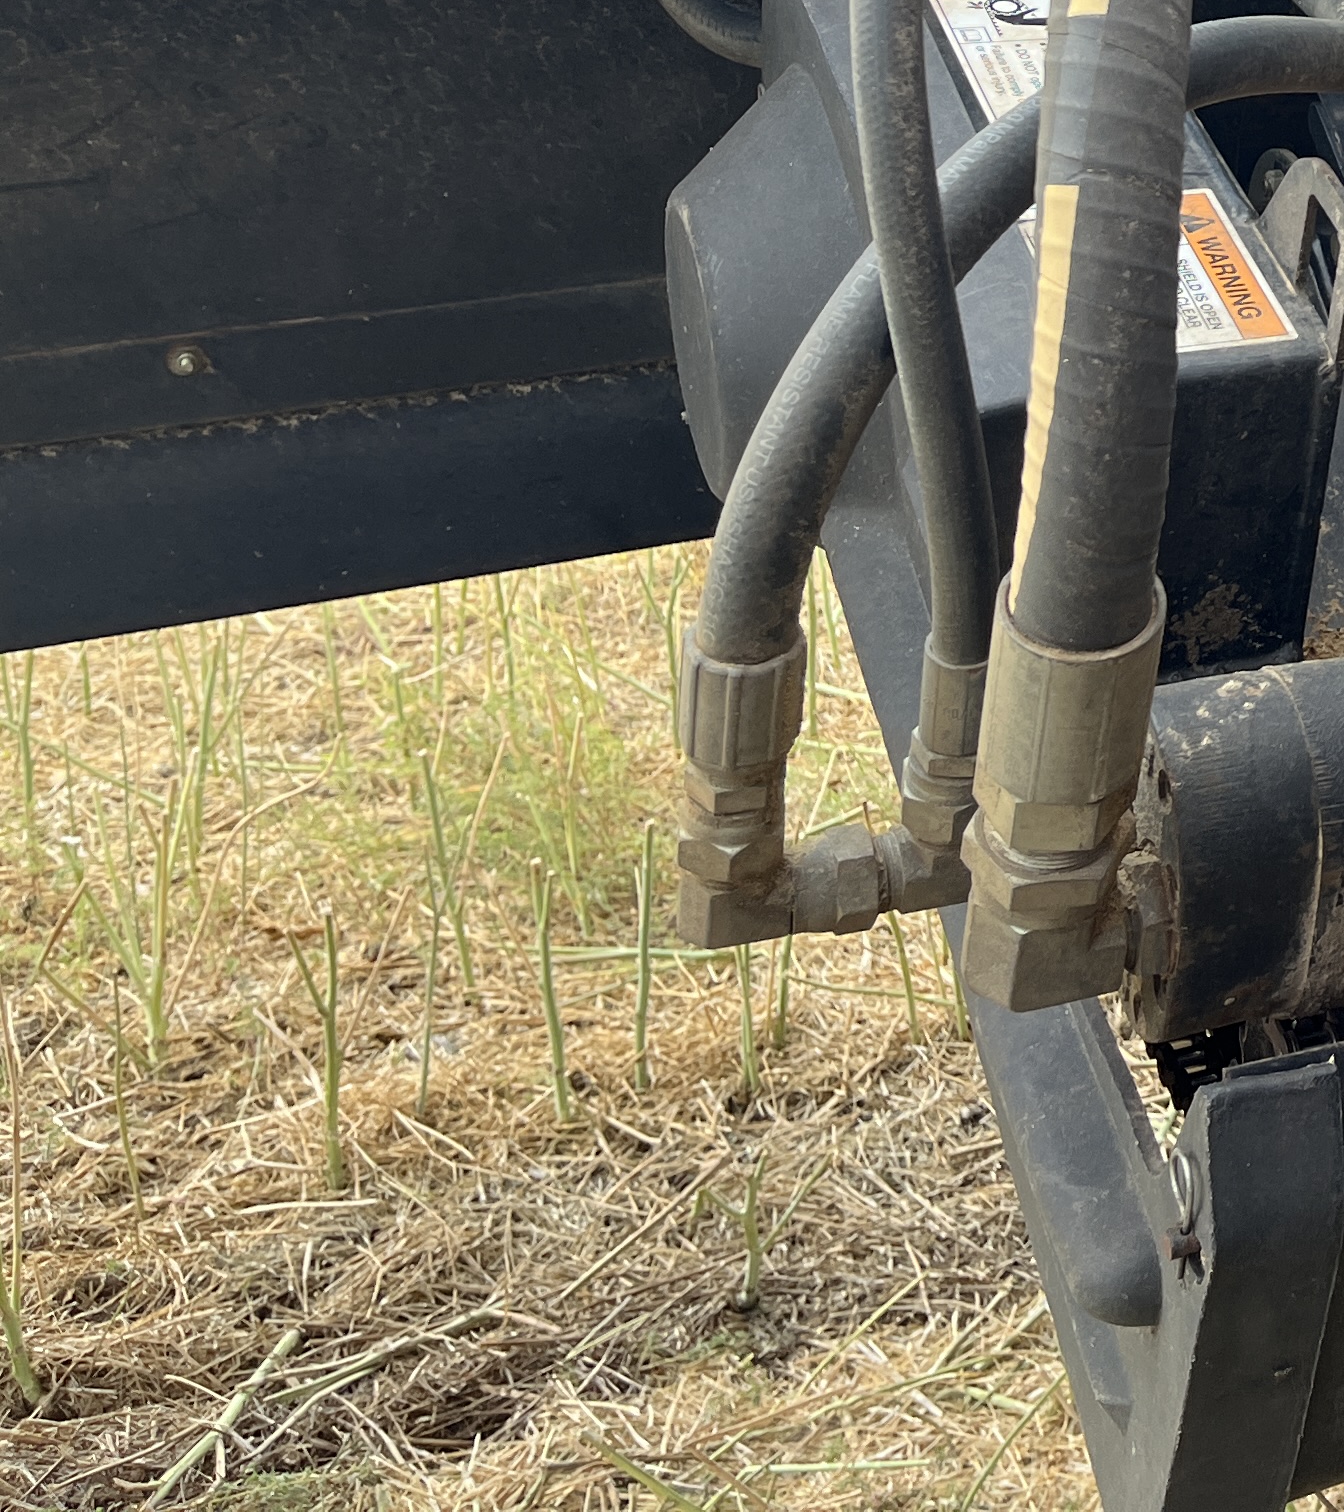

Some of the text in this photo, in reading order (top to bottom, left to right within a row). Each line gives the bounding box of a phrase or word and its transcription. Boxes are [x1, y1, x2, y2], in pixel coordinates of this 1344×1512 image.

[975, 44, 986, 54] or
[979, 52, 998, 77] serious
[990, 43, 1024, 98] Failure to comply
[1015, 46, 1039, 77] DO NOT
[826, 262, 880, 332] FLAME
[1177, 258, 1225, 331] SHIELD IS OPEN
[1197, 235, 1263, 320] WARNING
[1176, 299, 1204, 328] CLEAR
[756, 336, 830, 467] RESISTANT
